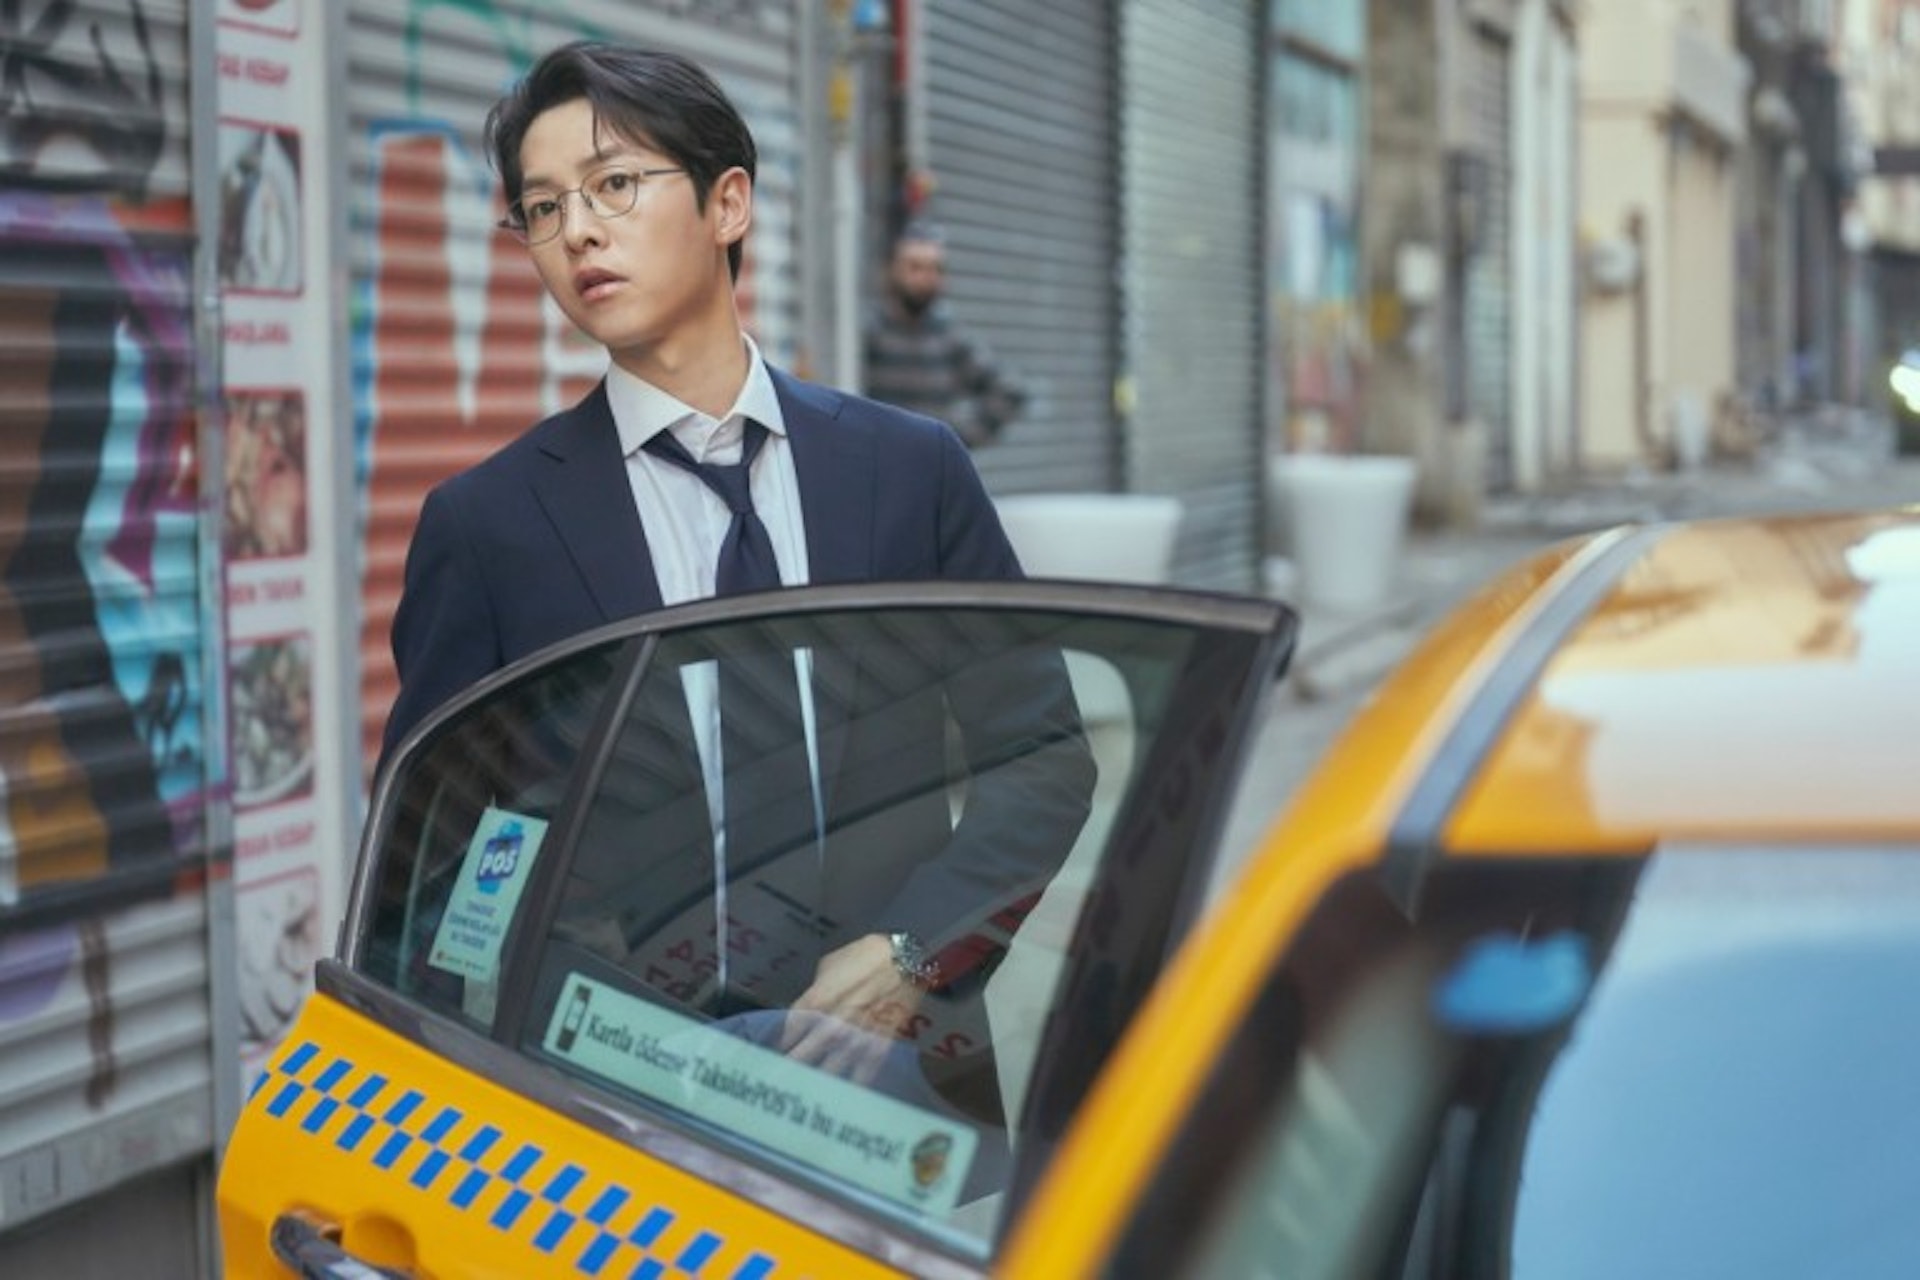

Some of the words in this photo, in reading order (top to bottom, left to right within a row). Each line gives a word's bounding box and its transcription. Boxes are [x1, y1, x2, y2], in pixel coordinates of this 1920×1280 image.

[478, 849, 517, 877] POS
[587, 1013, 633, 1053] Kartla
[635, 1033, 687, 1076] ödeme
[810, 1102, 833, 1137] bu
